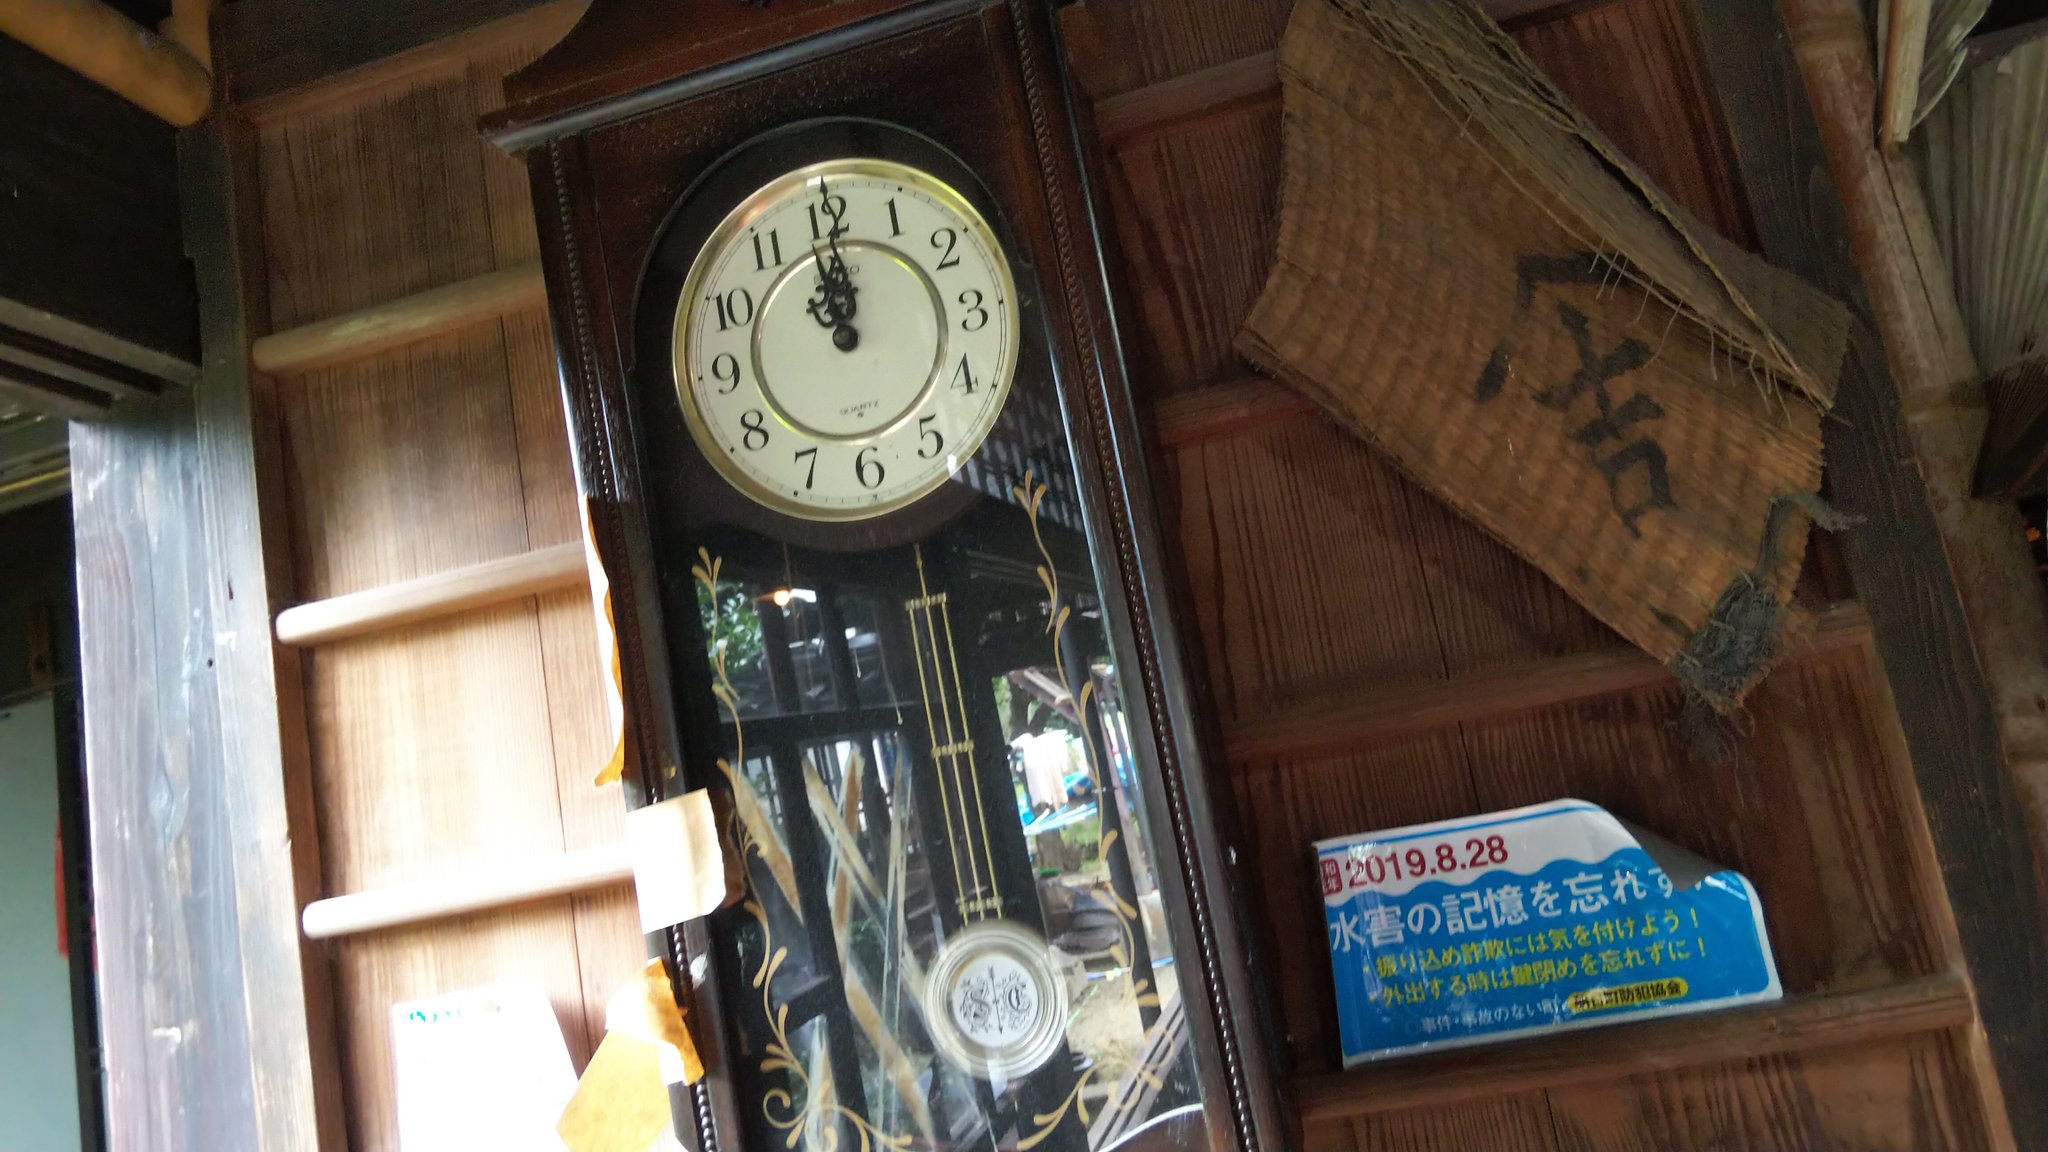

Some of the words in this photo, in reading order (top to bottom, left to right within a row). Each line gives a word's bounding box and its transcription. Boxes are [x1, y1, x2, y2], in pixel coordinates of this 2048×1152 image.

[805, 196, 849, 241] 12
[884, 198, 904, 238] 1
[752, 228, 783, 272] 11
[931, 228, 960, 271] 2
[710, 287, 754, 332] 10
[958, 290, 988, 331] 3
[711, 353, 740, 394] 9
[951, 353, 979, 395] 4
[740, 409, 770, 451] 8
[917, 414, 943, 459] 5
[795, 447, 818, 490] 7
[855, 446, 885, 489] 6
[1345, 836, 1509, 889] 2019.8.28
